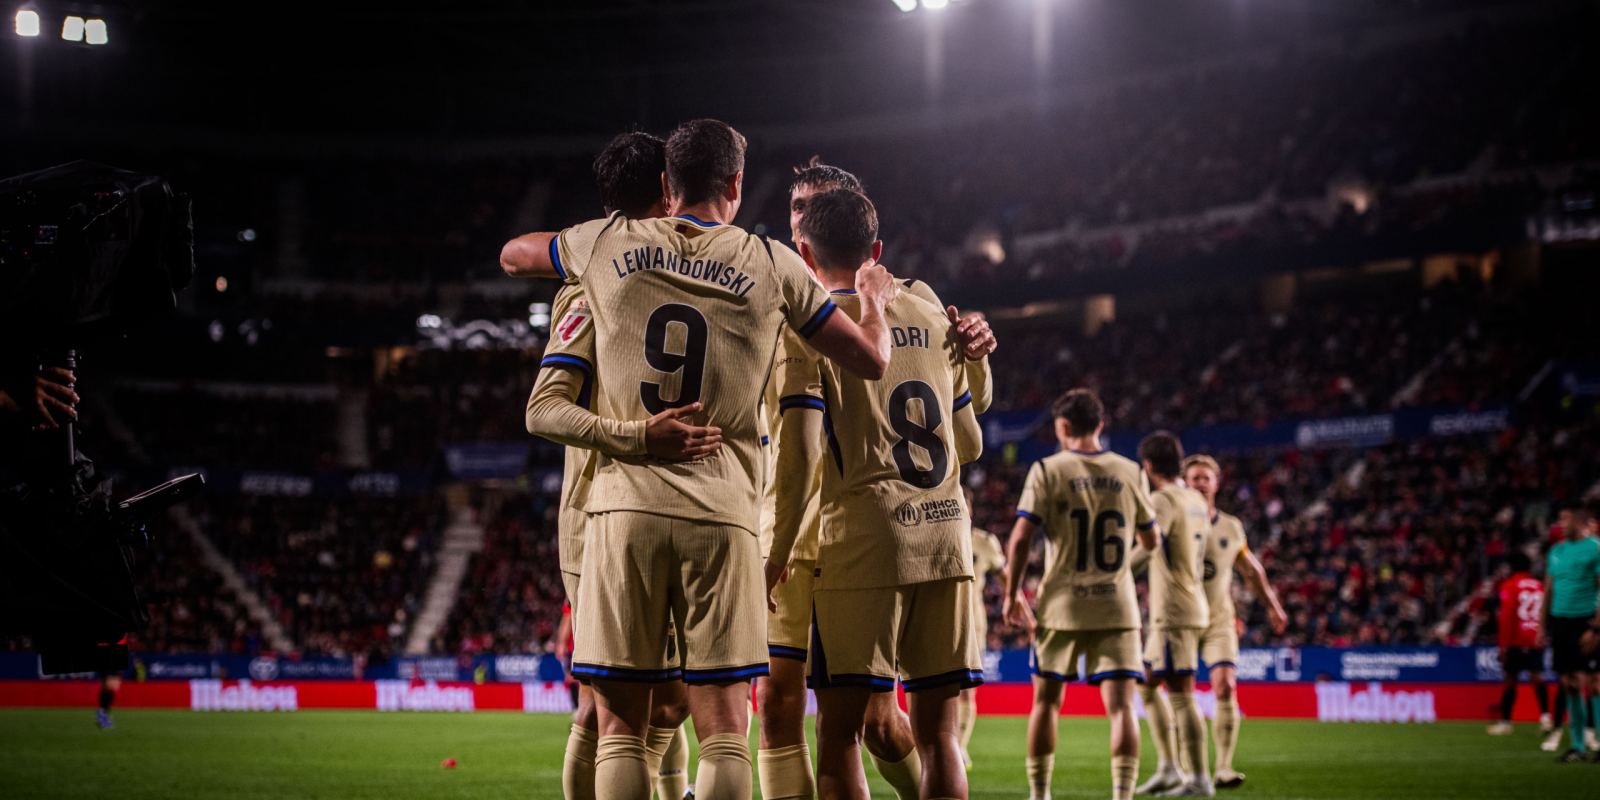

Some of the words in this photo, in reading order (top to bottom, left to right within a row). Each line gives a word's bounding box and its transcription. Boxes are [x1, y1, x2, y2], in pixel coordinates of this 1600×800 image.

[612, 246, 756, 299] LEWANDOWSKI
[890, 326, 930, 349] DRI
[640, 302, 709, 418] 9
[888, 379, 948, 490] 8
[920, 499, 960, 511] UNHCR
[1071, 509, 1125, 573] 16
[189, 678, 298, 711] Mahou
[375, 679, 475, 712] Mahou
[1315, 682, 1437, 722] Mahou
